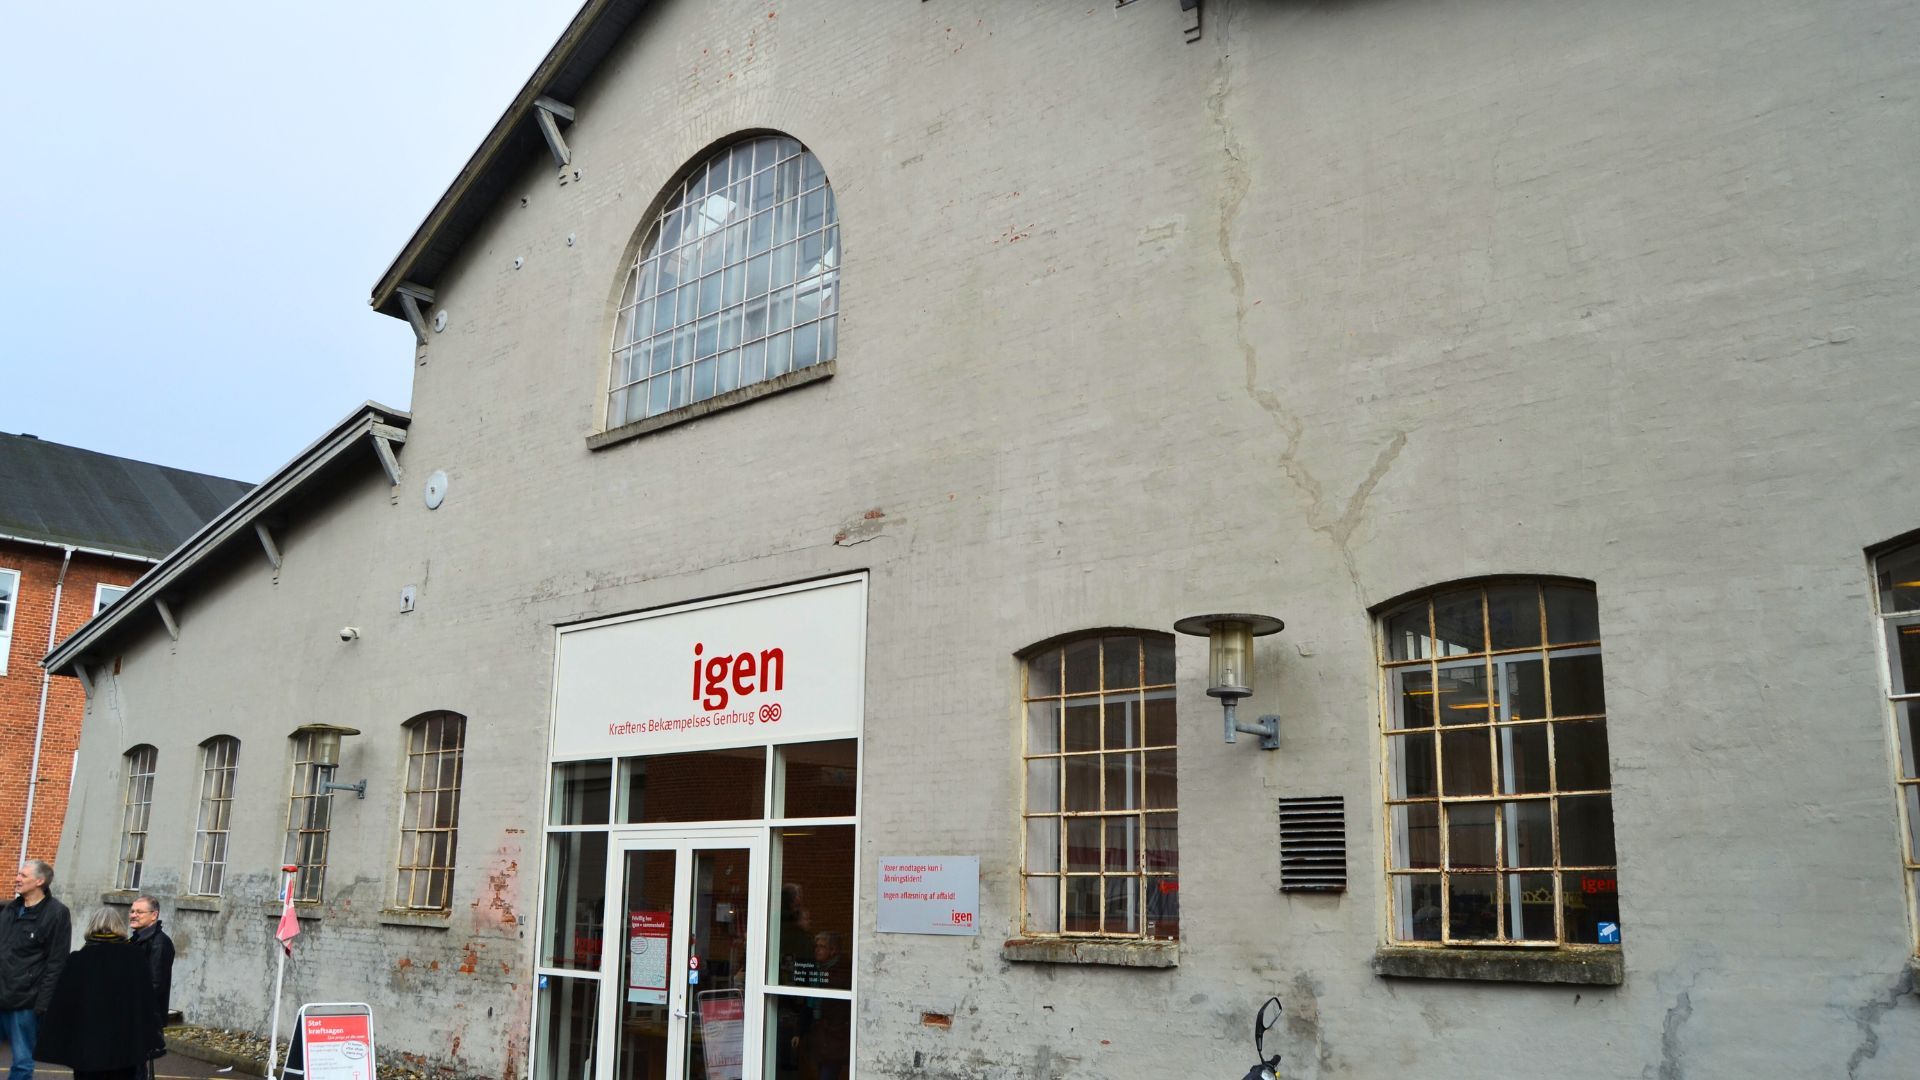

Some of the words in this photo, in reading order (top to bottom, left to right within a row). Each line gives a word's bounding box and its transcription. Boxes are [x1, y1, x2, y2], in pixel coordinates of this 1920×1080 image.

[693, 643, 784, 711] igen
[609, 720, 646, 736] Kræftens
[648, 714, 711, 732] Bekæmpelses
[713, 710, 755, 726] Genbrug
[899, 864, 927, 873] modtages
[928, 864, 939, 872] kun
[1583, 875, 1616, 895] igen
[883, 892, 899, 901] Ingen
[929, 892, 935, 900] af
[951, 909, 973, 923] igen
